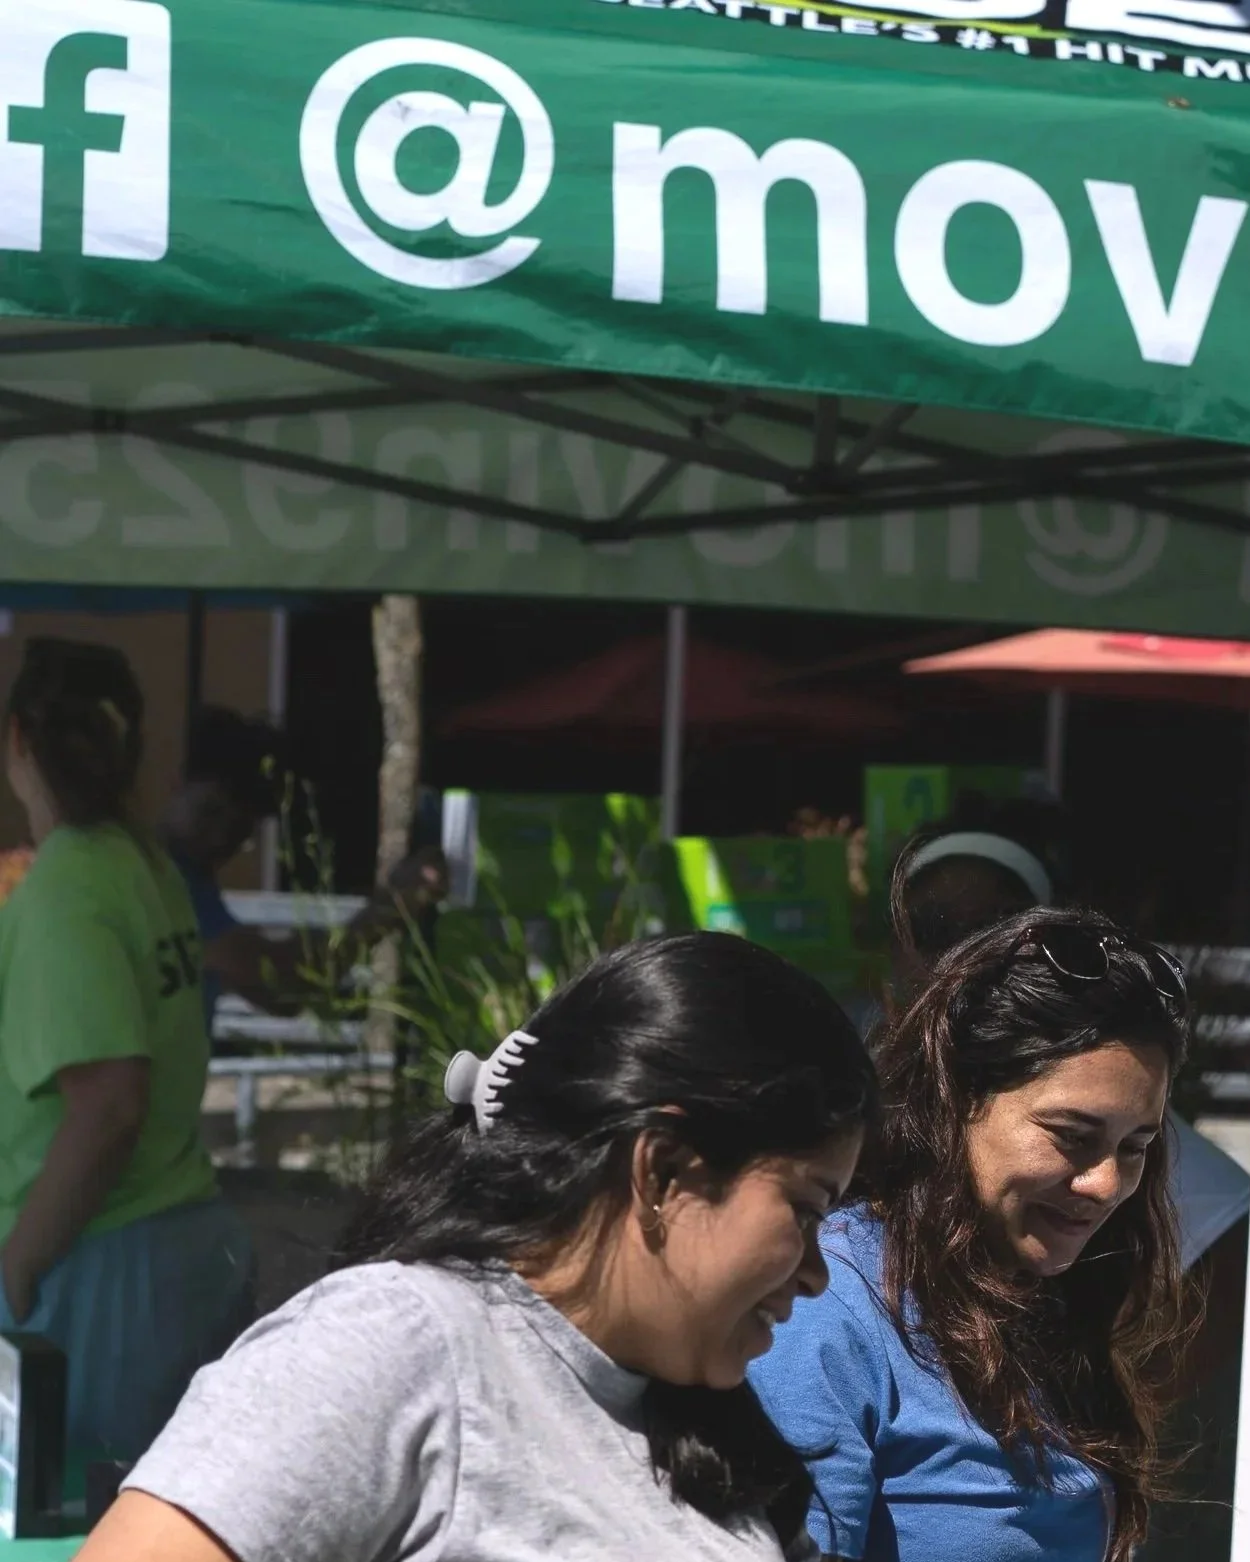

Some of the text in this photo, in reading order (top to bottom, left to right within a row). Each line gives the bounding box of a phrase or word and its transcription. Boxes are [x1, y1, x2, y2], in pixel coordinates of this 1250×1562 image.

[594, 0, 940, 43] EATTLE'S
[957, 26, 1031, 56] #1
[1054, 38, 1167, 73] HIT
